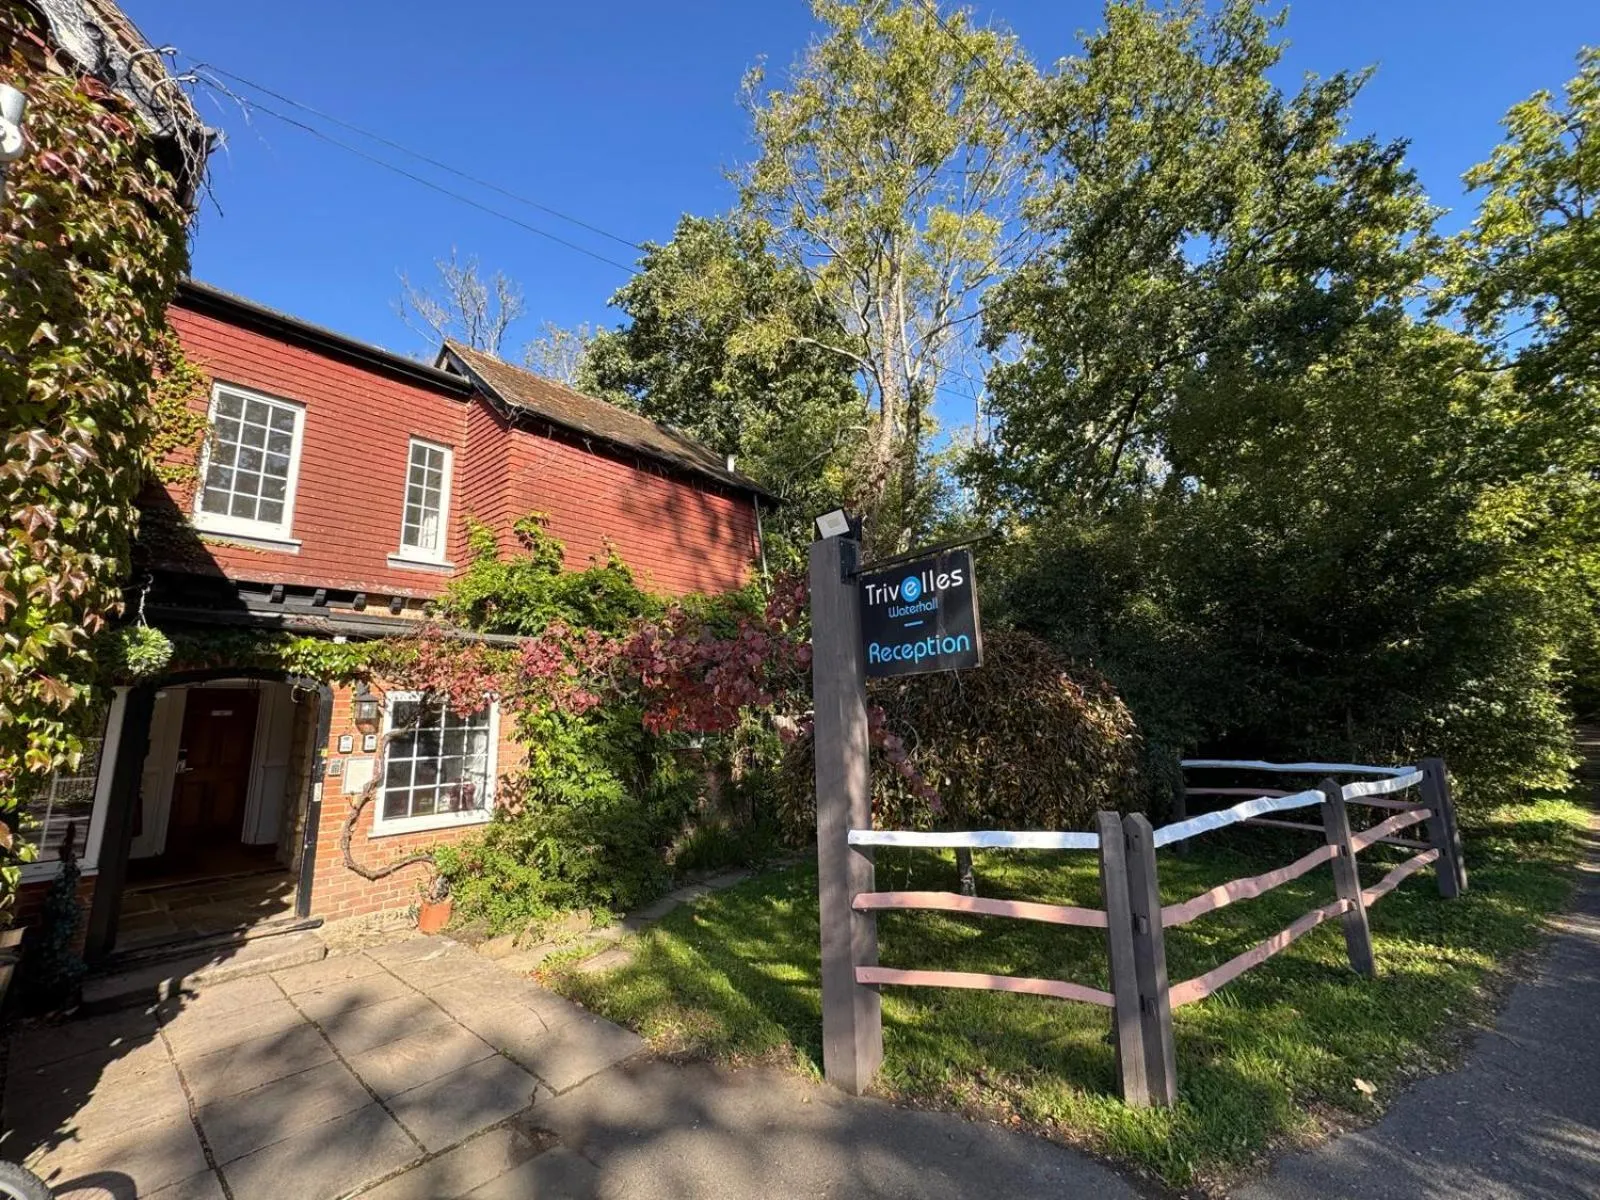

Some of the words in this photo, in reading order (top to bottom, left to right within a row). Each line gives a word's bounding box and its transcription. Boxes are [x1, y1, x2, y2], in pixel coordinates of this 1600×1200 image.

[866, 568, 964, 605] Trivelles
[888, 598, 938, 618] Waterhall
[869, 634, 970, 664] Reception
